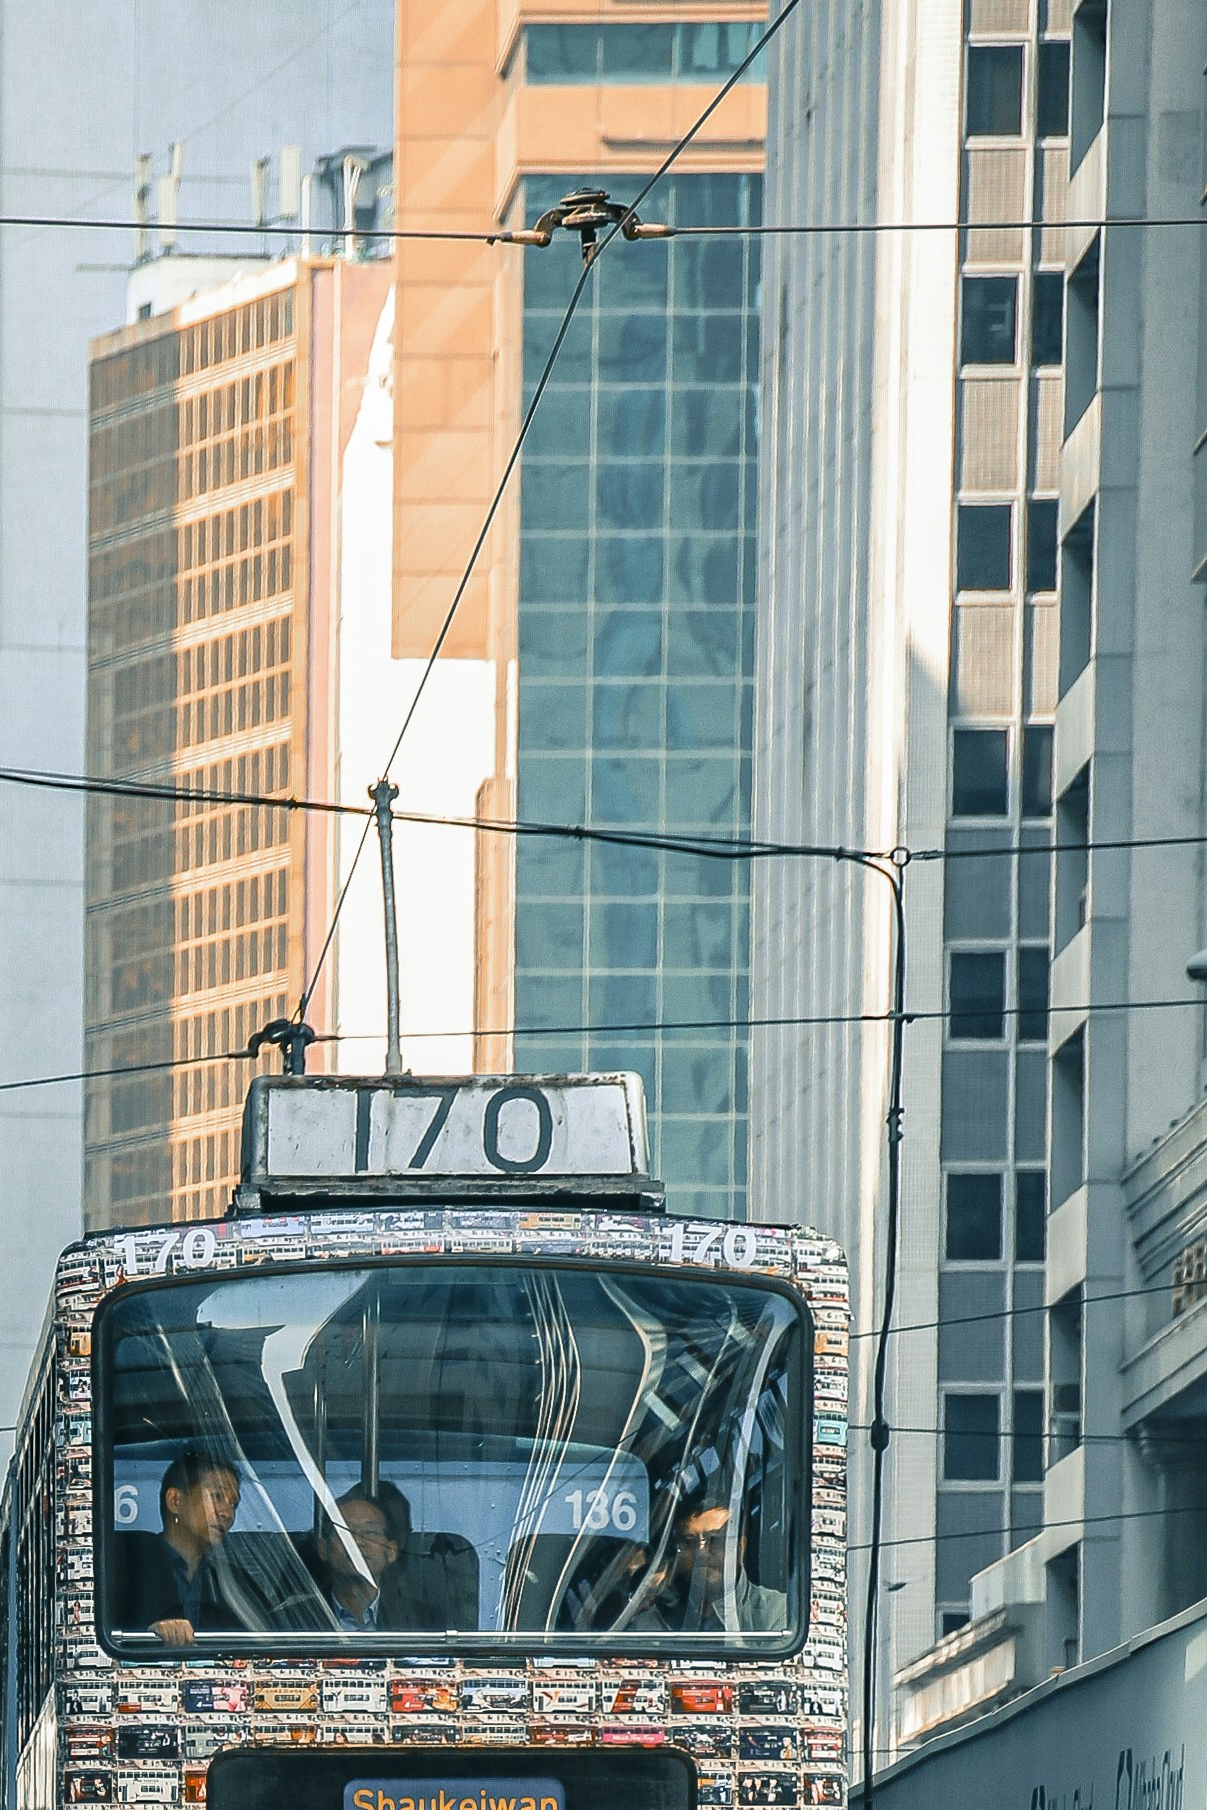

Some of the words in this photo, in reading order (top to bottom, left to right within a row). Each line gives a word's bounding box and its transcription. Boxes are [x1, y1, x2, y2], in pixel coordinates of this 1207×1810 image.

[355, 1085, 553, 1174] 170
[114, 1228, 216, 1275] 170
[661, 1223, 757, 1267] 170
[564, 1489, 638, 1531] 136
